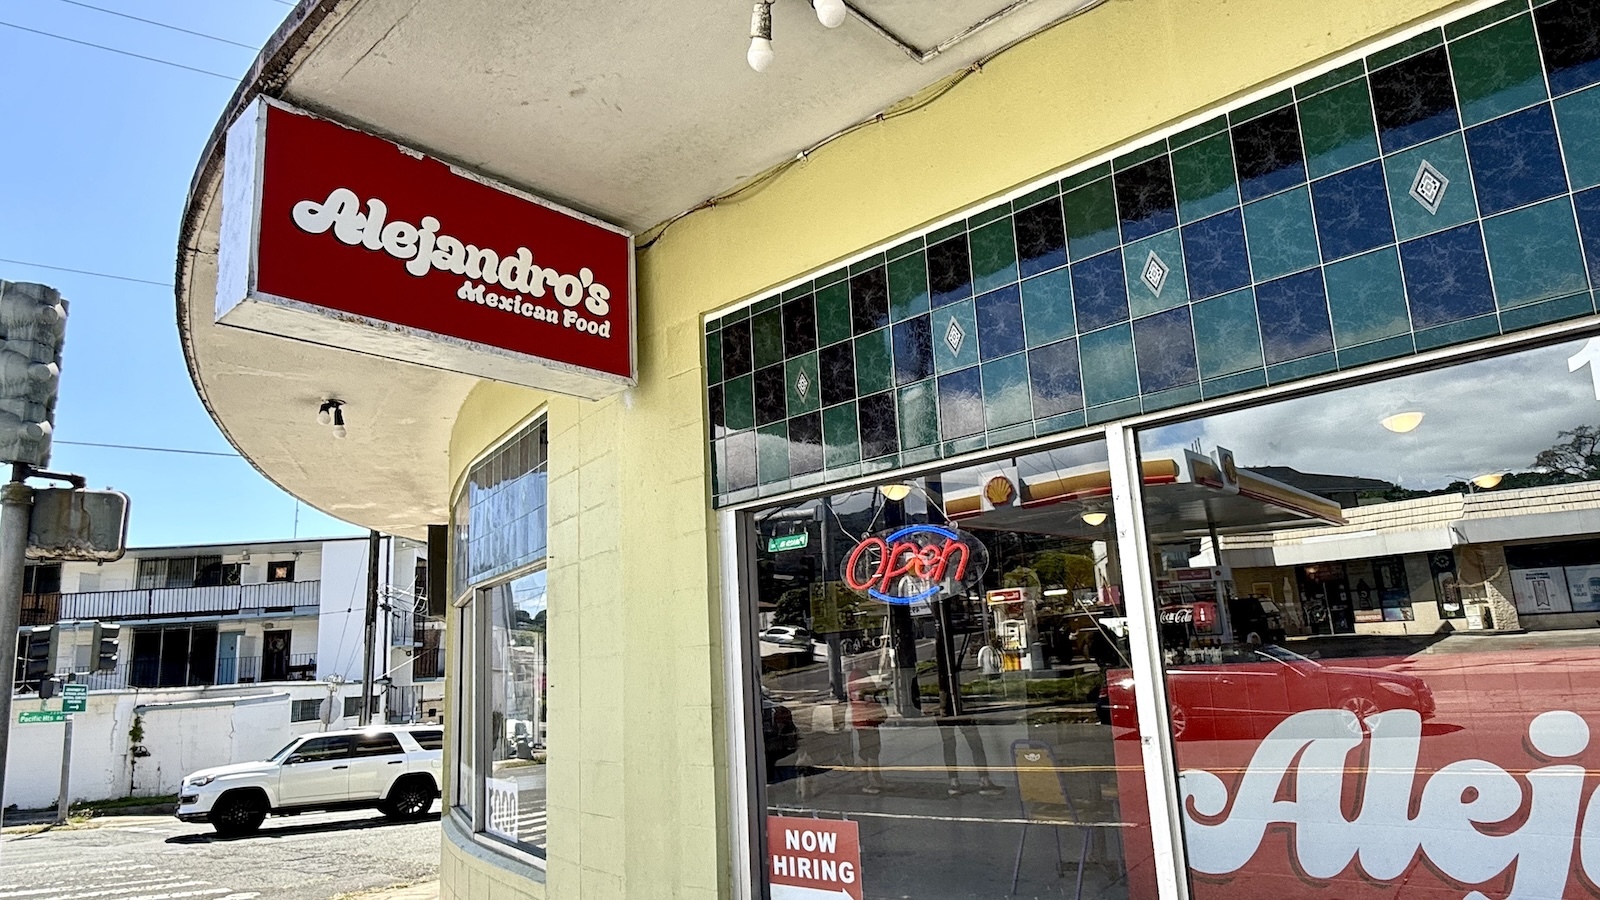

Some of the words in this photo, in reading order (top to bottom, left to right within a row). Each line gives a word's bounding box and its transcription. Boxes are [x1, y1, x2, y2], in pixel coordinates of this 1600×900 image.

[292, 187, 610, 316] Alejandro's
[457, 280, 559, 324] Mexican
[562, 308, 611, 338] Food
[846, 537, 970, 594] Open
[20, 715, 43, 723] Pacific
[785, 829, 837, 854] NOW
[773, 855, 855, 884] HIRING
